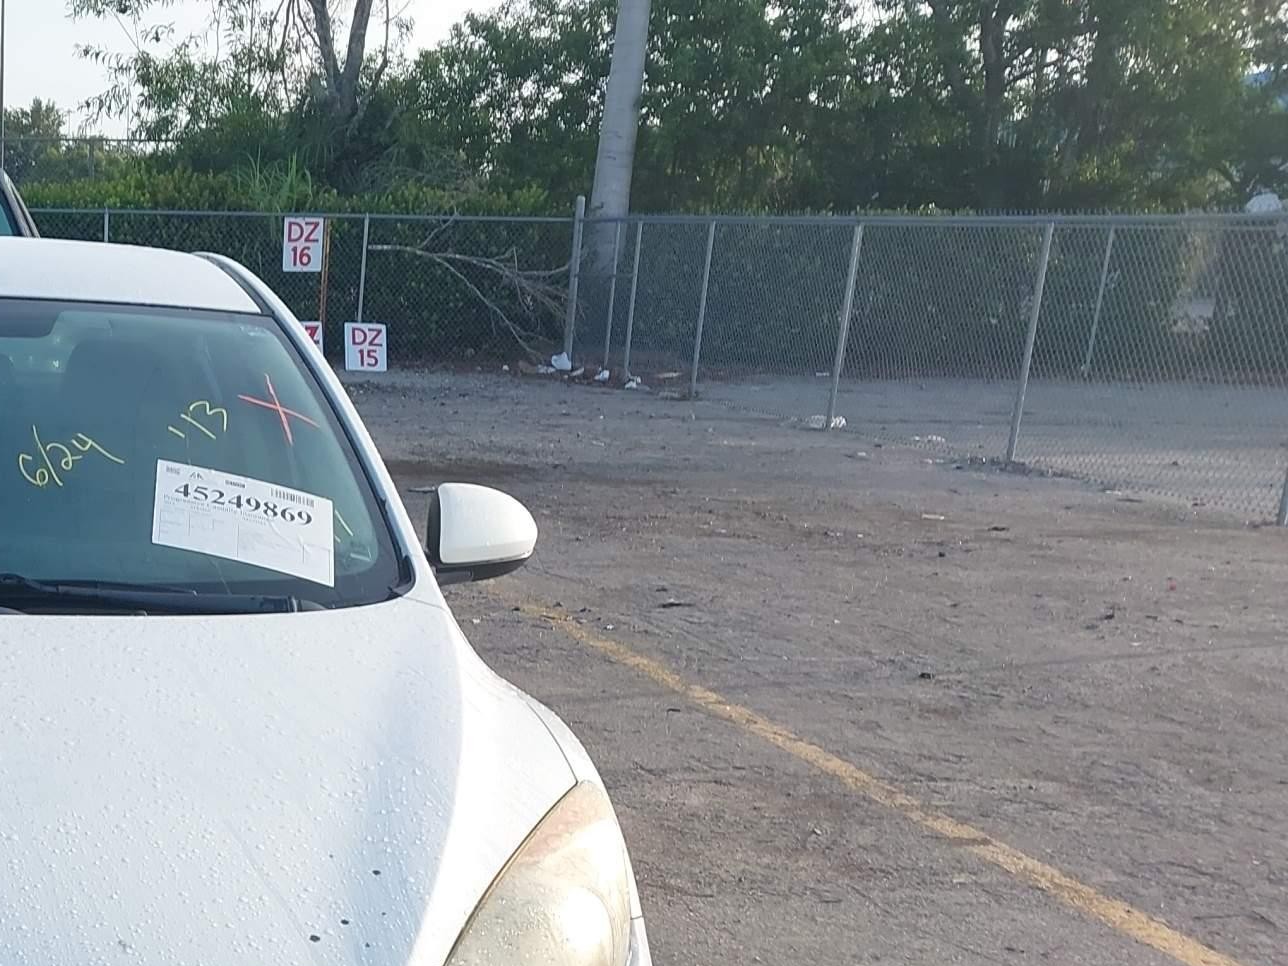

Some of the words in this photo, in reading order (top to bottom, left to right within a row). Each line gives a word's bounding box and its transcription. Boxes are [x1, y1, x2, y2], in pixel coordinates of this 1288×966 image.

[287, 221, 319, 243] DZ
[291, 246, 312, 267] 16
[351, 327, 383, 347] DZ
[358, 350, 379, 368] 15
[18, 424, 125, 487] 6/24
[174, 483, 313, 526] 45249869
